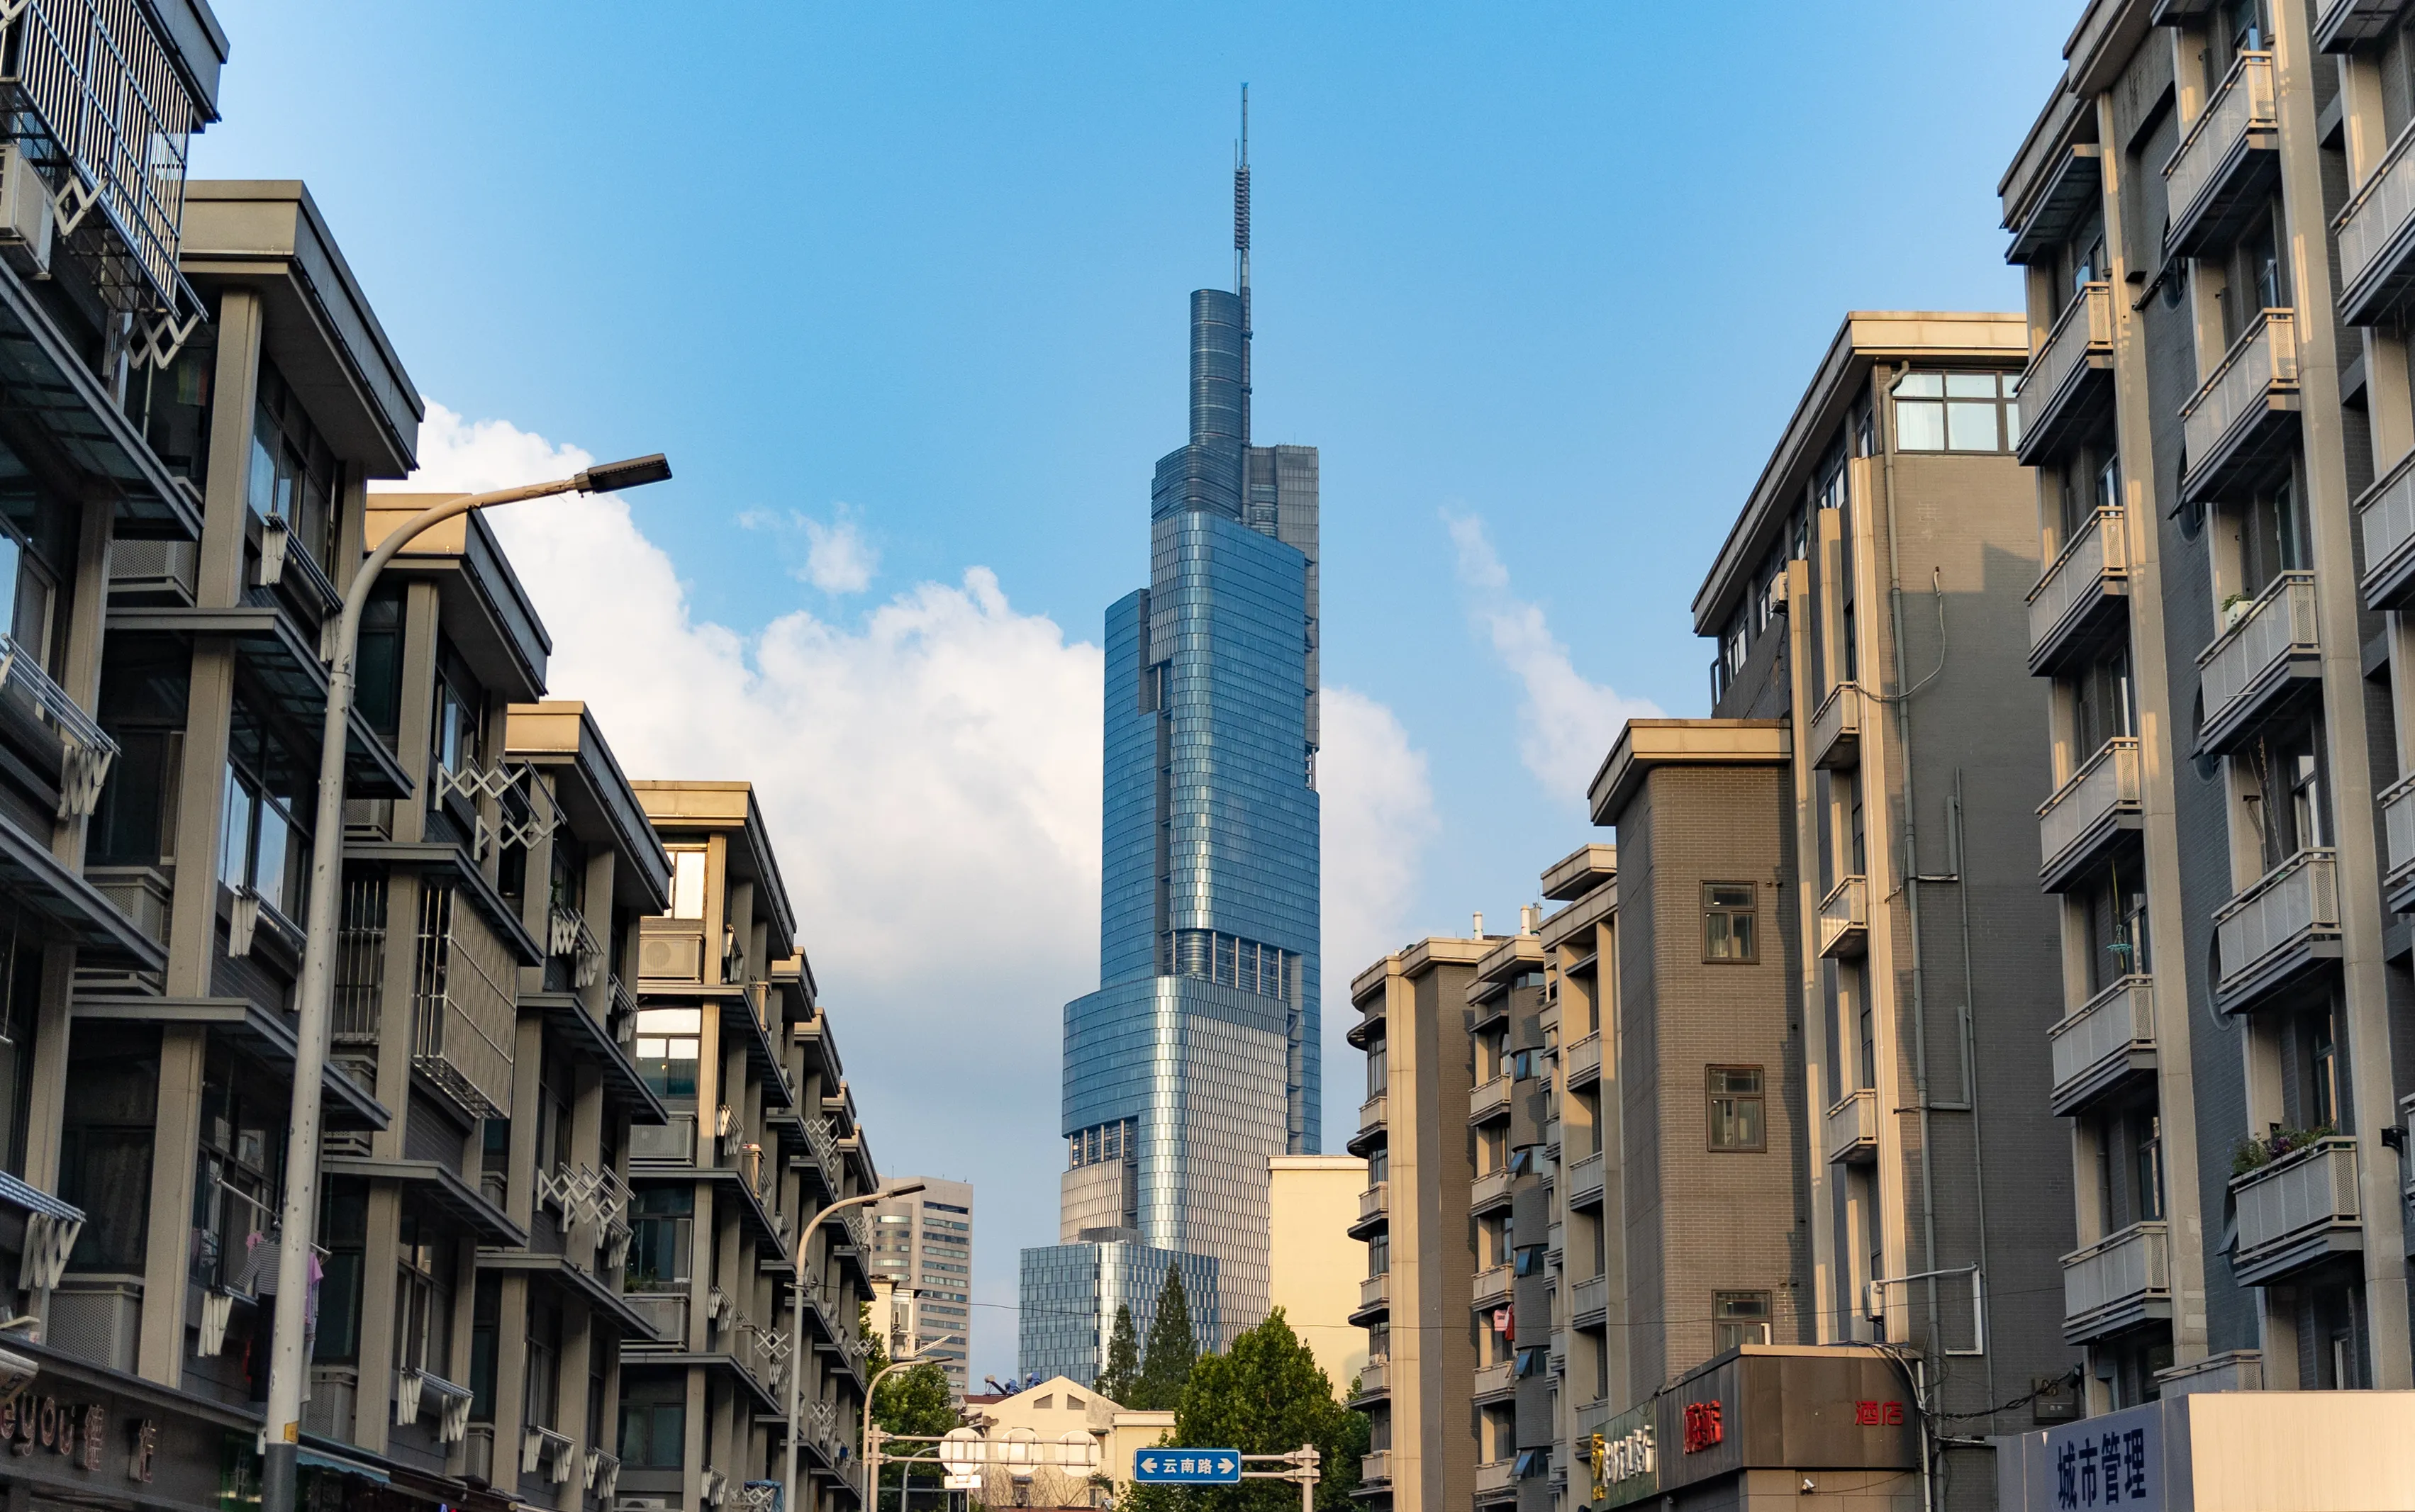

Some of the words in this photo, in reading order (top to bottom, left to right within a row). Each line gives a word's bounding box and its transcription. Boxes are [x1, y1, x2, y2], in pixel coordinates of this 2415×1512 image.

[1855, 1400, 1904, 1426] 酒店
[1163, 1457, 1213, 1474] 云南路
[2058, 1428, 2146, 1511] 城市管理
